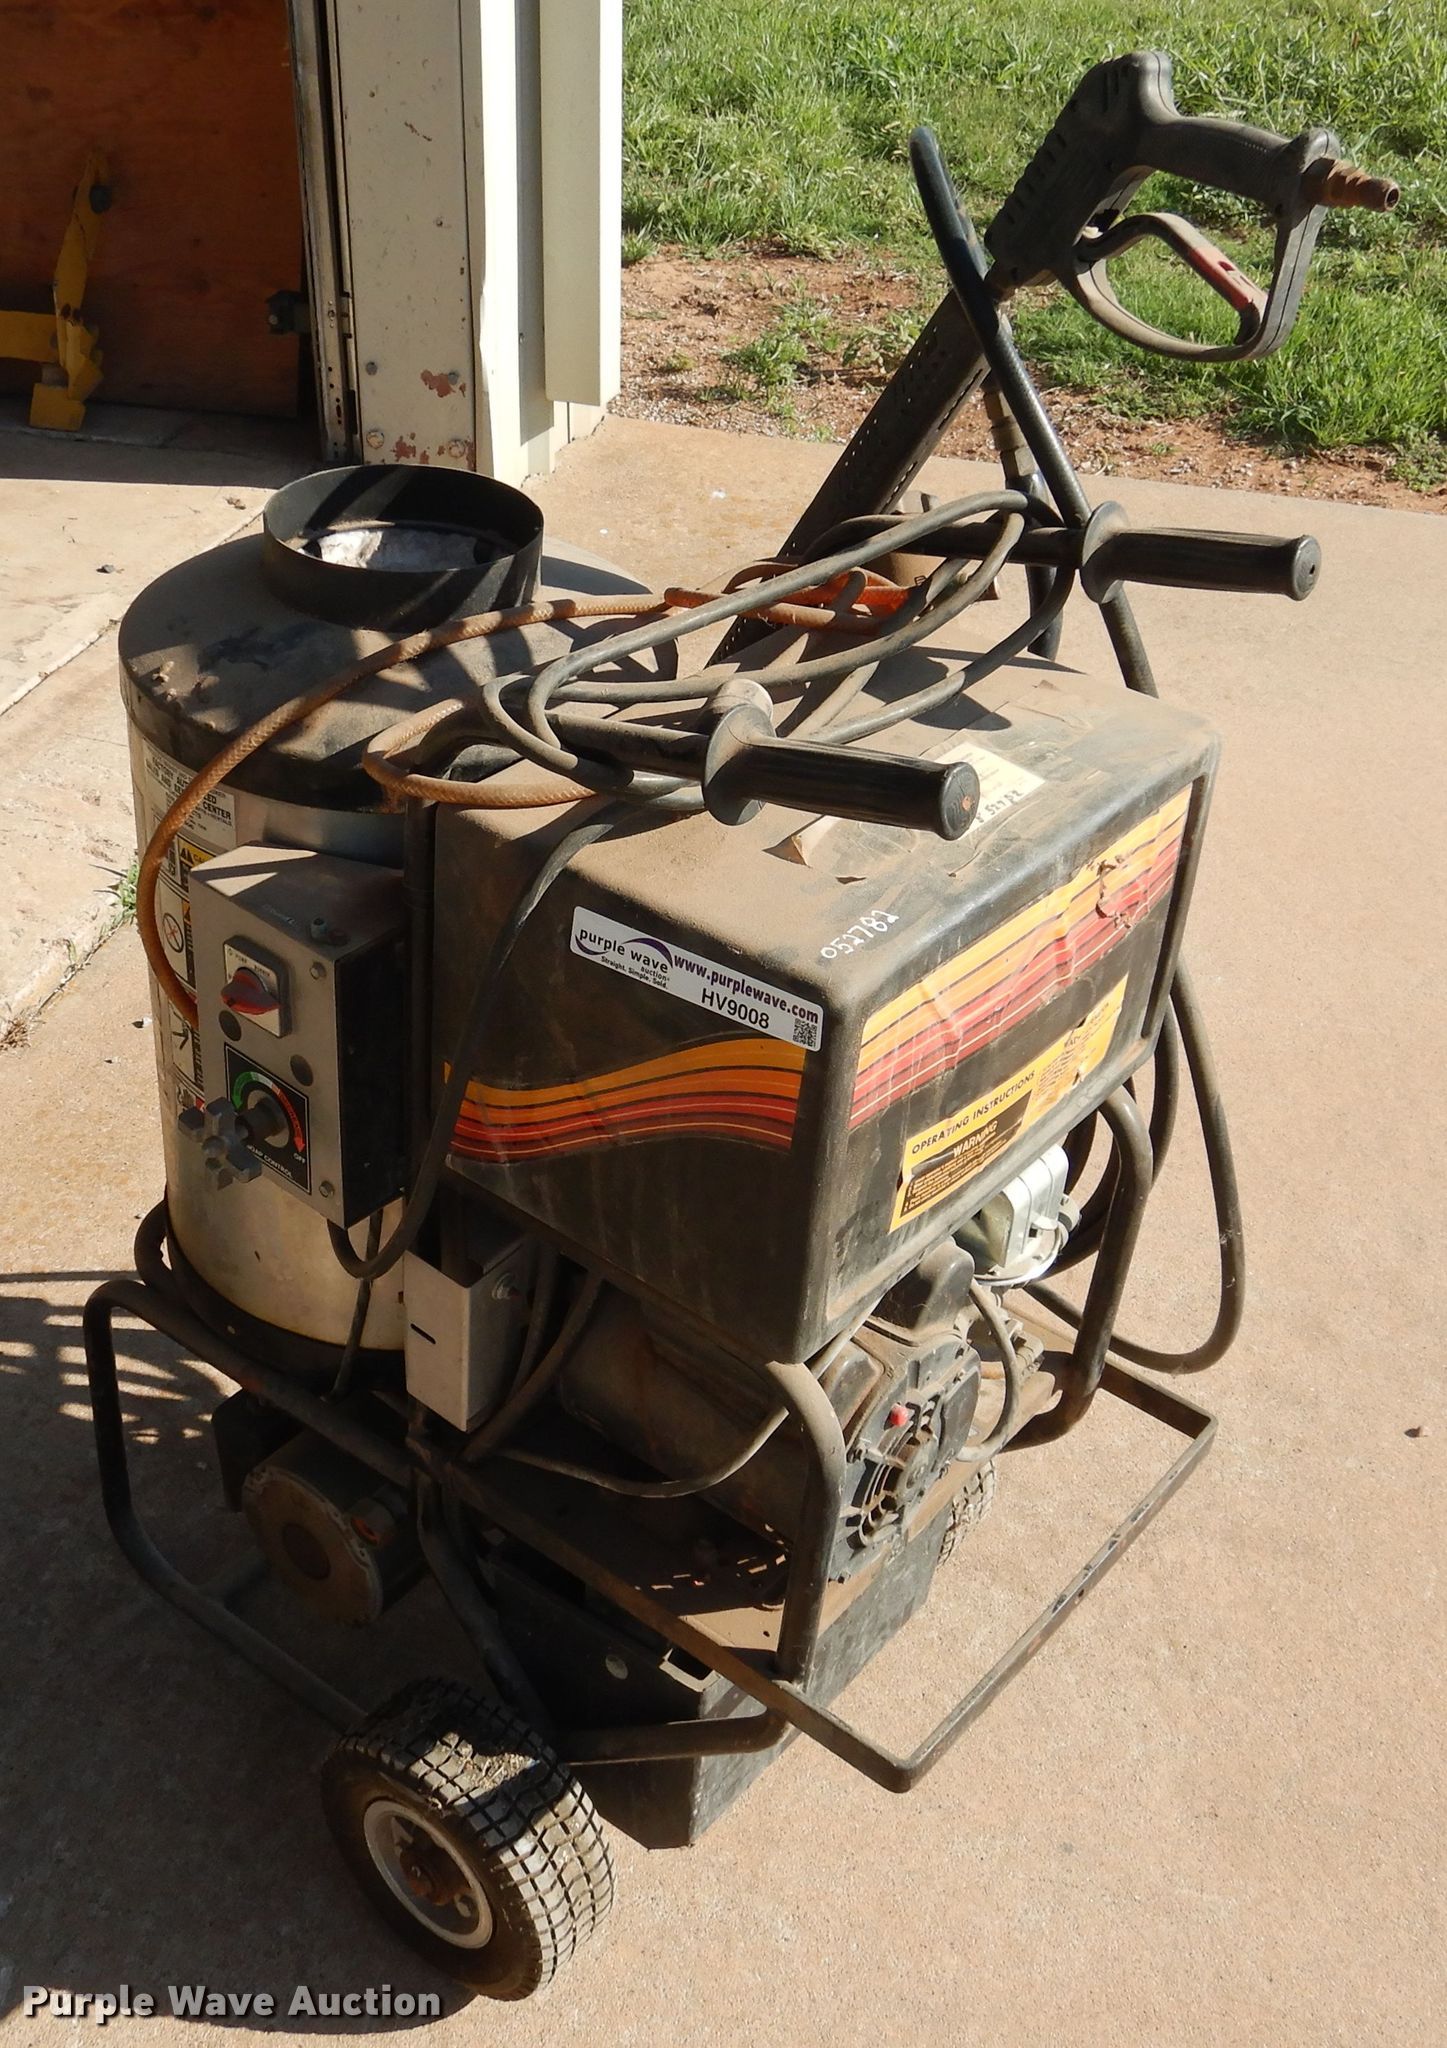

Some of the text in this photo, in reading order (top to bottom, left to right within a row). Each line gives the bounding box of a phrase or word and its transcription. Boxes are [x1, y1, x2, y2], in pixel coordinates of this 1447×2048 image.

[202, 801, 232, 820] CENTER
[579, 929, 668, 974] purple wave
[673, 955, 819, 1024] www.purplewave.com
[701, 988, 770, 1030] HV9008
[911, 1117, 970, 1154] OPERATING
[973, 1070, 1036, 1120] INSTRUCTIONS
[952, 1120, 999, 1158] WARNING
[263, 1154, 293, 1178] CONTROL
